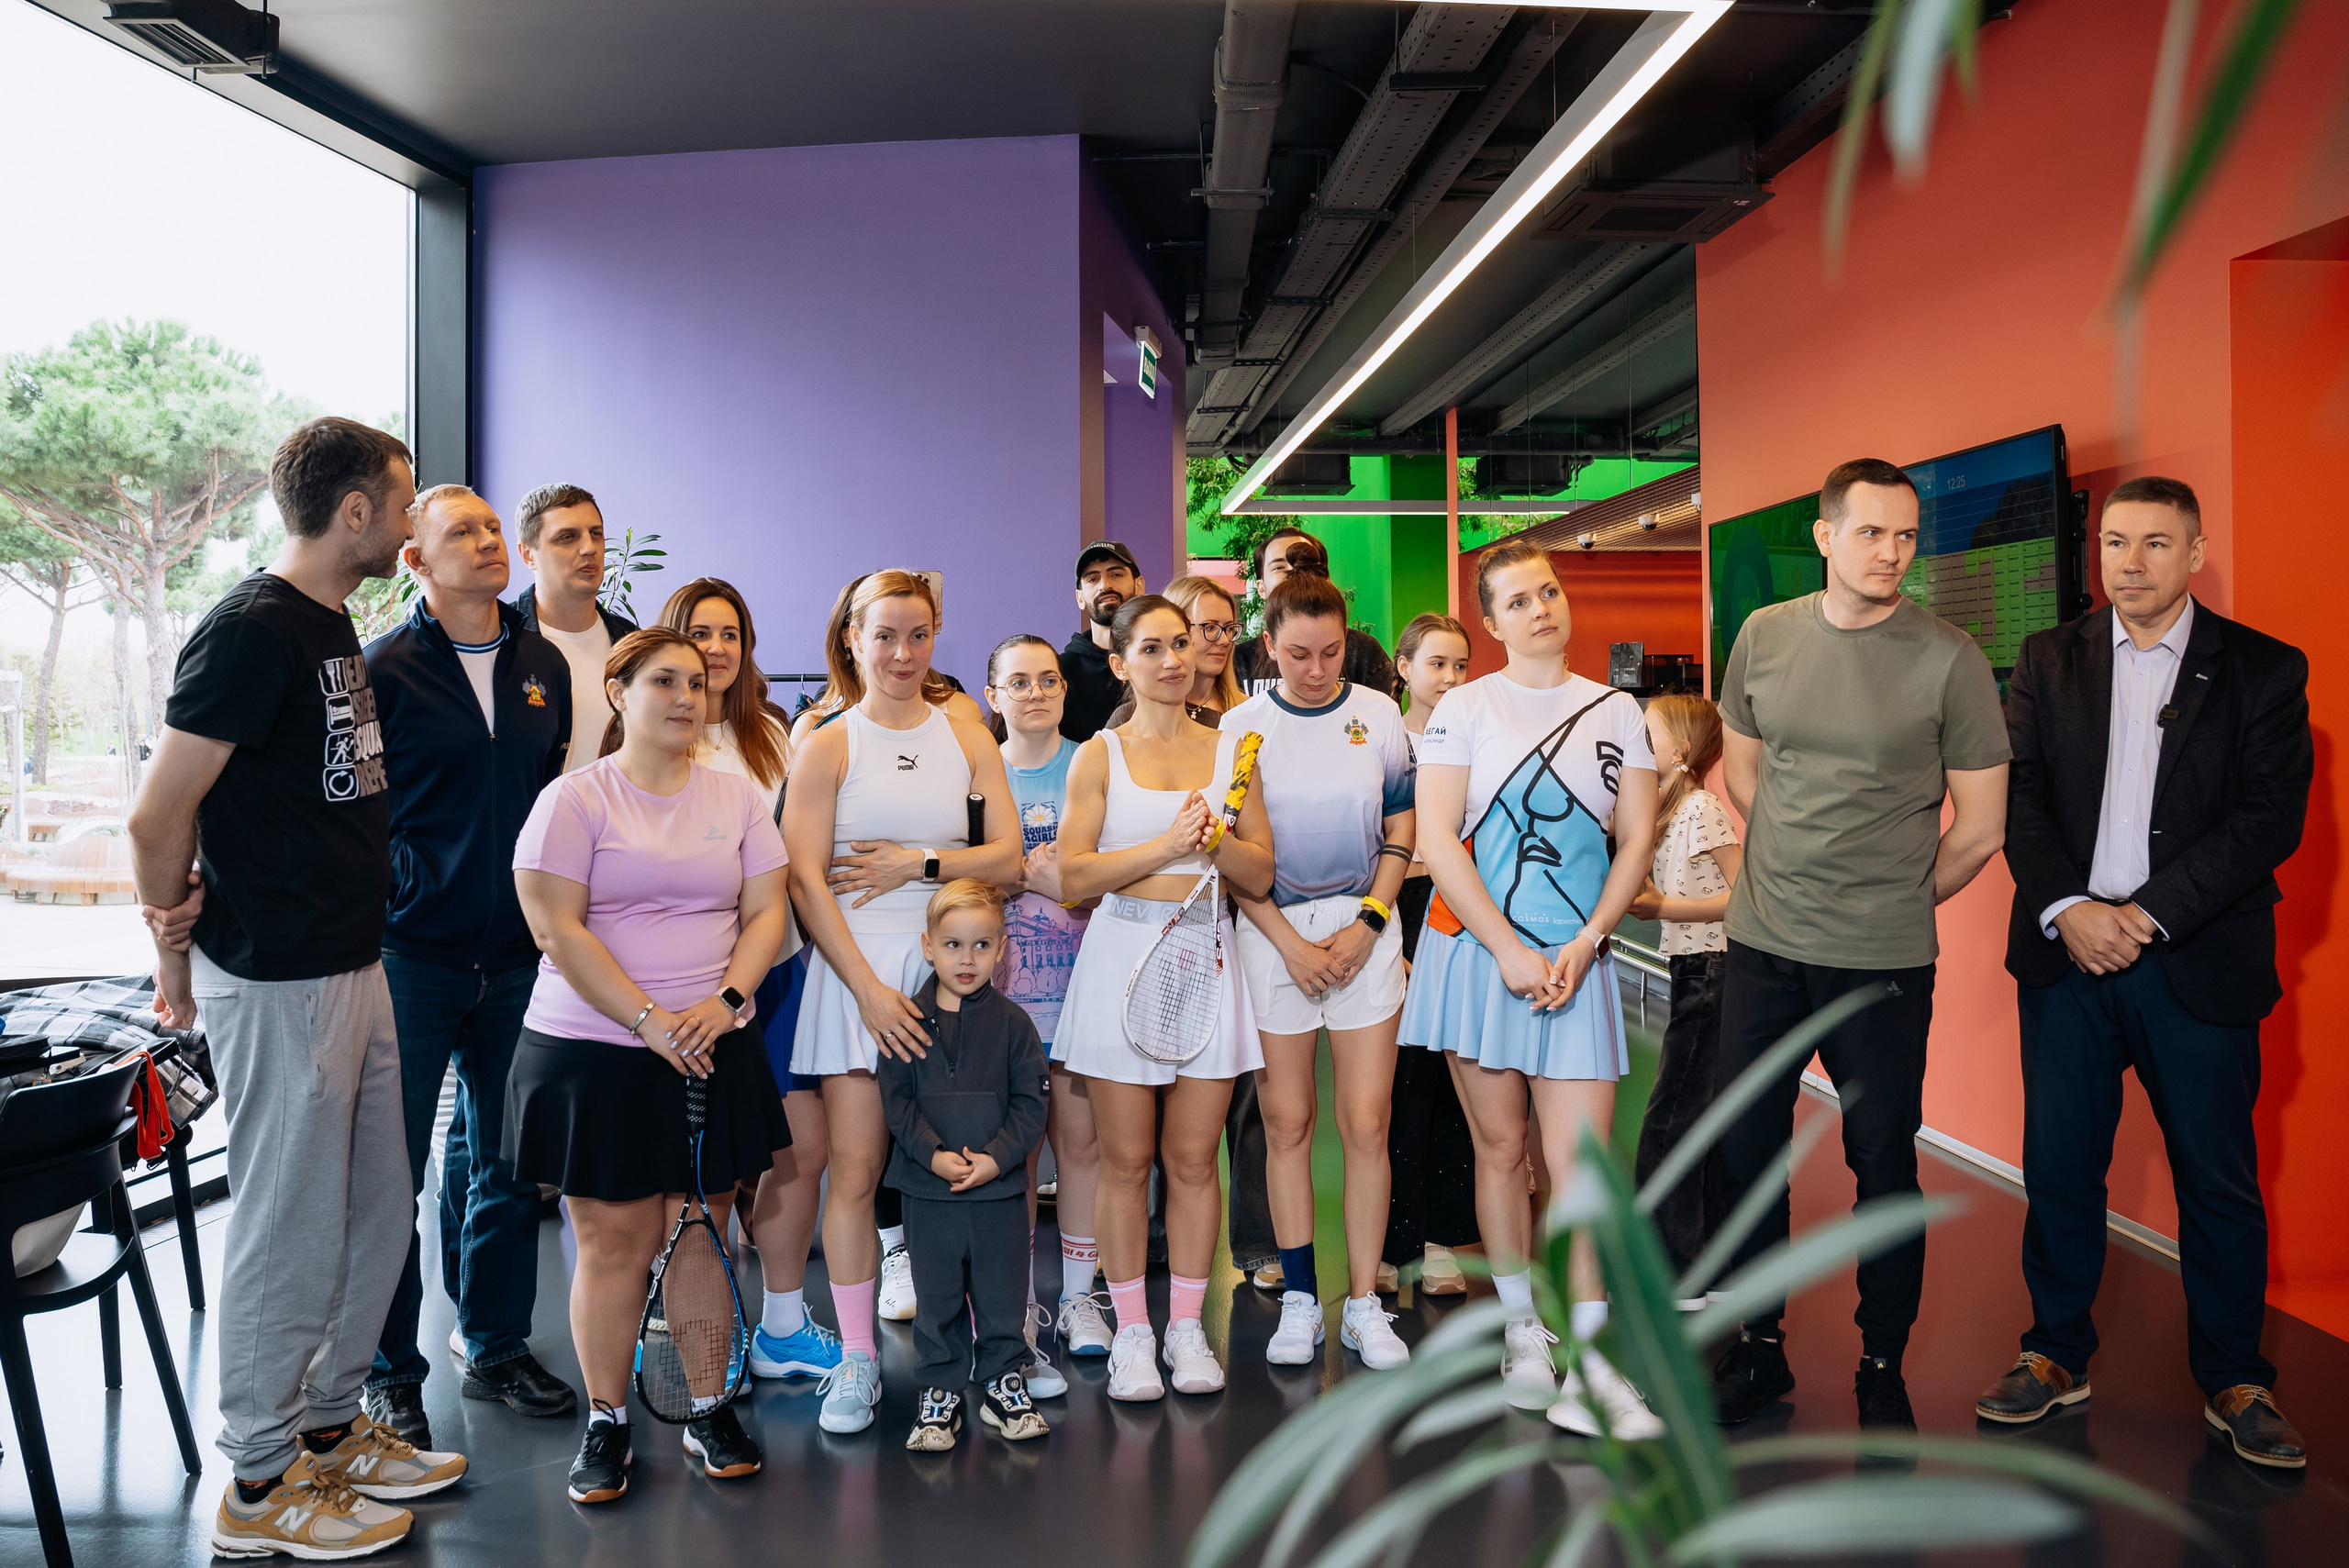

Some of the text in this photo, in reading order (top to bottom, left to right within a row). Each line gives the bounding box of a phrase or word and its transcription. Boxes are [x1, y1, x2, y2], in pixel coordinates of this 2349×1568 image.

[1947, 474, 1965, 490] 12:25
[1023, 825, 1058, 837] SQUASH
[1512, 915, 1550, 924] COSMOS
